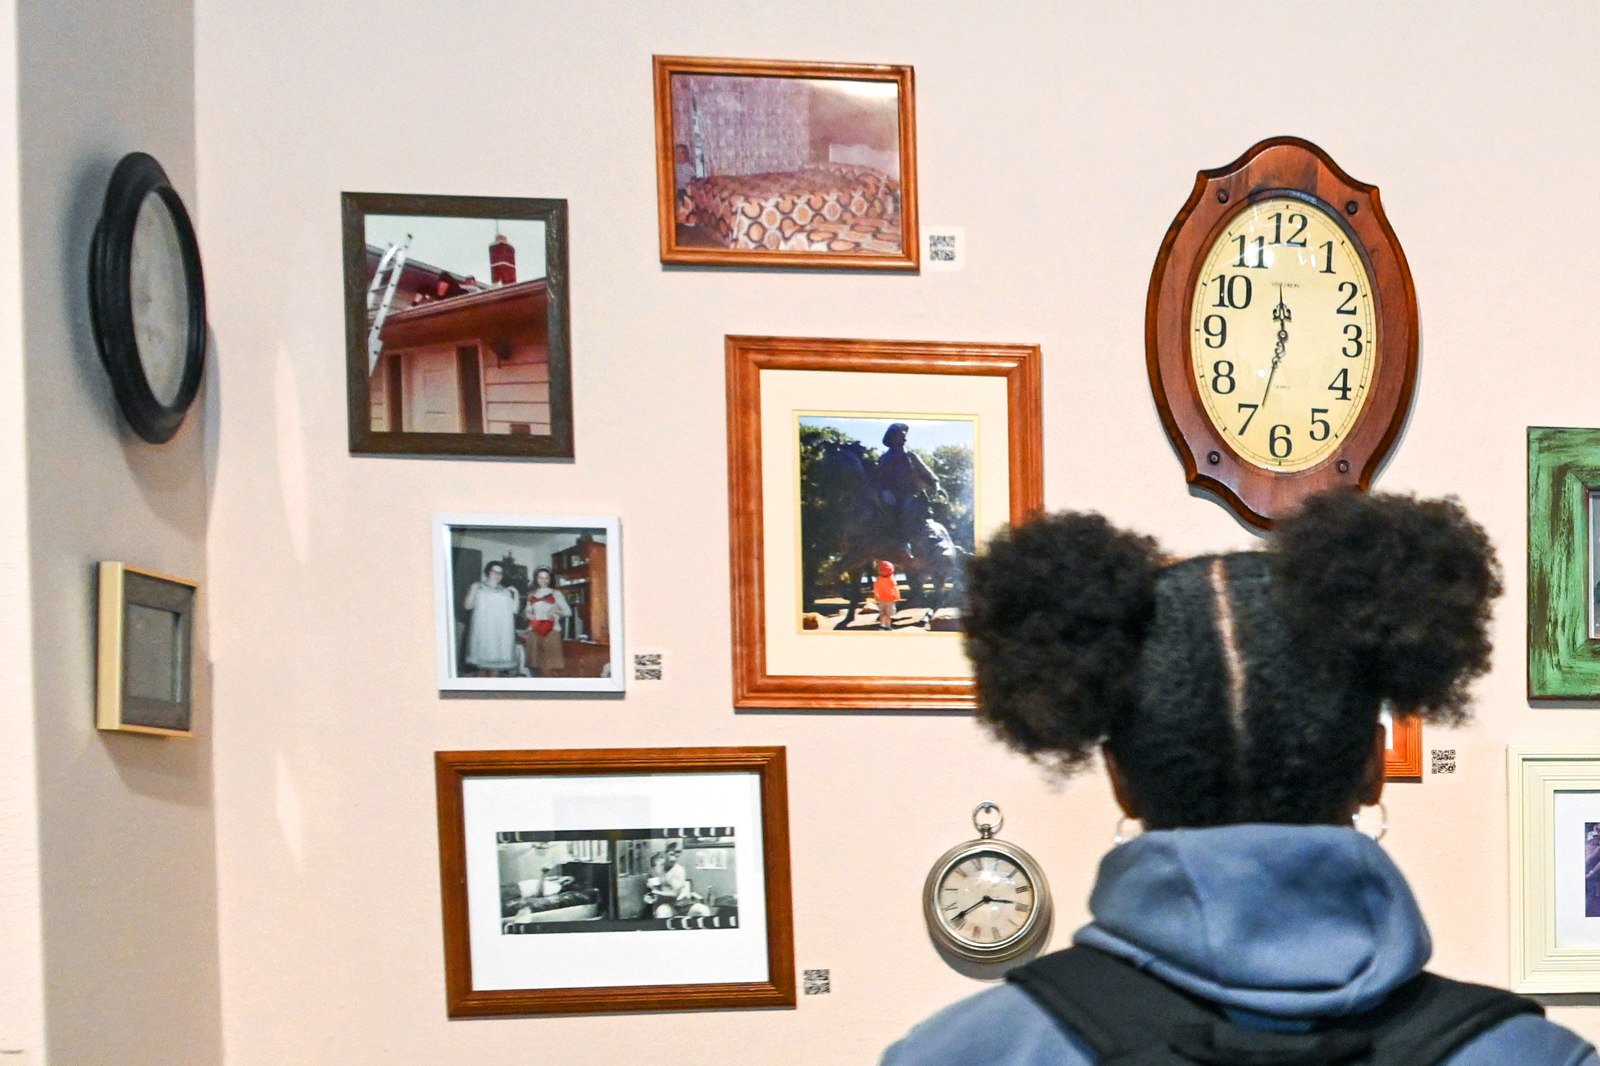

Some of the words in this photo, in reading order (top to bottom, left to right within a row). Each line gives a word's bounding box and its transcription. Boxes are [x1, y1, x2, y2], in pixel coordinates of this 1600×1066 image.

[1266, 212, 1308, 248] 12
[1231, 235, 1269, 270] 11
[1318, 241, 1337, 274] 1
[1211, 274, 1252, 310] 10
[1336, 281, 1358, 316] 2
[1203, 314, 1227, 349] 9
[1341, 324, 1363, 358] 3
[1211, 360, 1236, 395] 8
[1328, 368, 1352, 401] 4
[1237, 403, 1259, 436] 7
[1309, 408, 1331, 442] 5
[1268, 424, 1293, 459] 6
